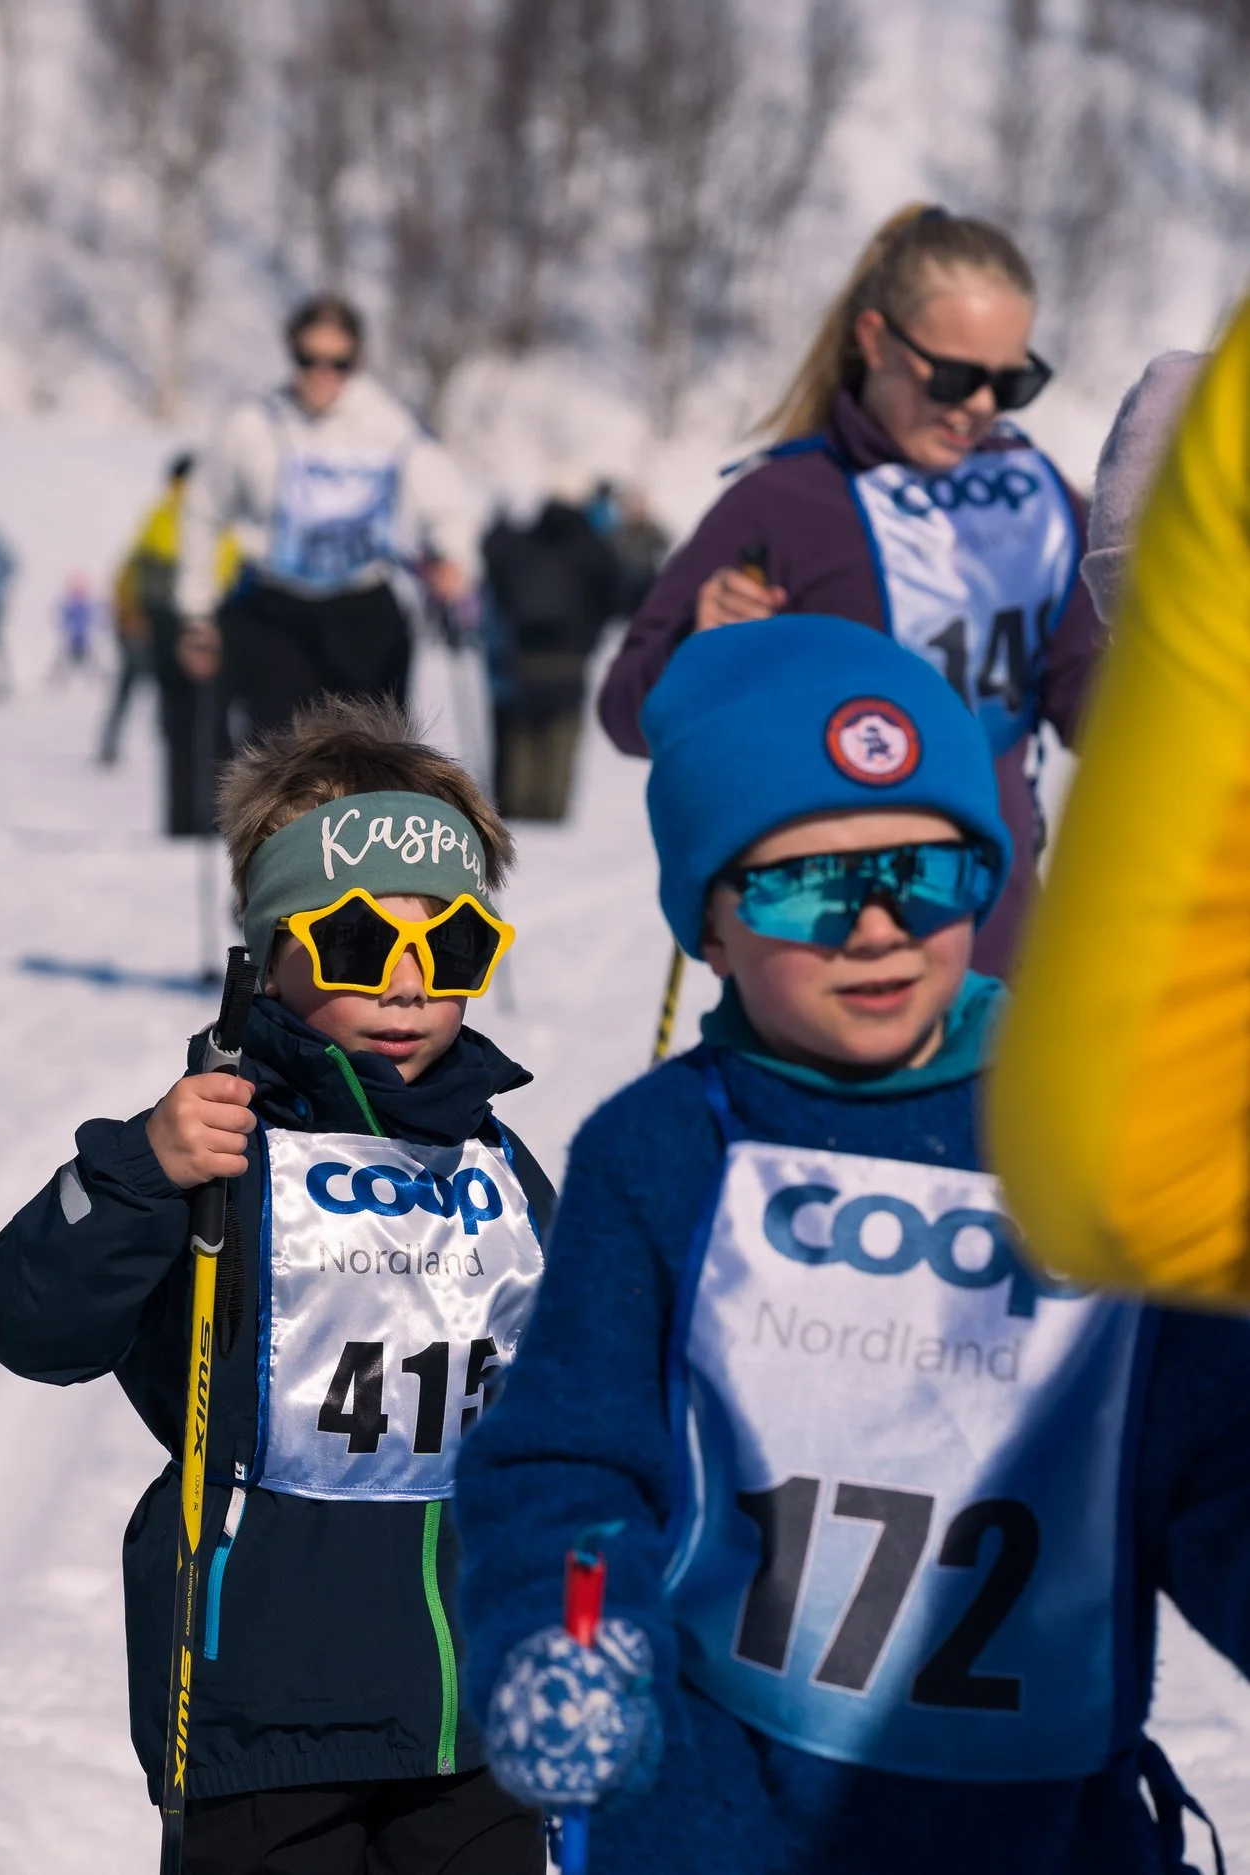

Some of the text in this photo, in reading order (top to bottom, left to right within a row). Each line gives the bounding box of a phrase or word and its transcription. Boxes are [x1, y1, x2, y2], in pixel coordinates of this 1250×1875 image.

[892, 469, 1040, 516] coop
[305, 1161, 504, 1236] coop
[318, 1240, 486, 1277] Nordland
[751, 1300, 1024, 1383] Nordland
[731, 1471, 1041, 1712] 172
